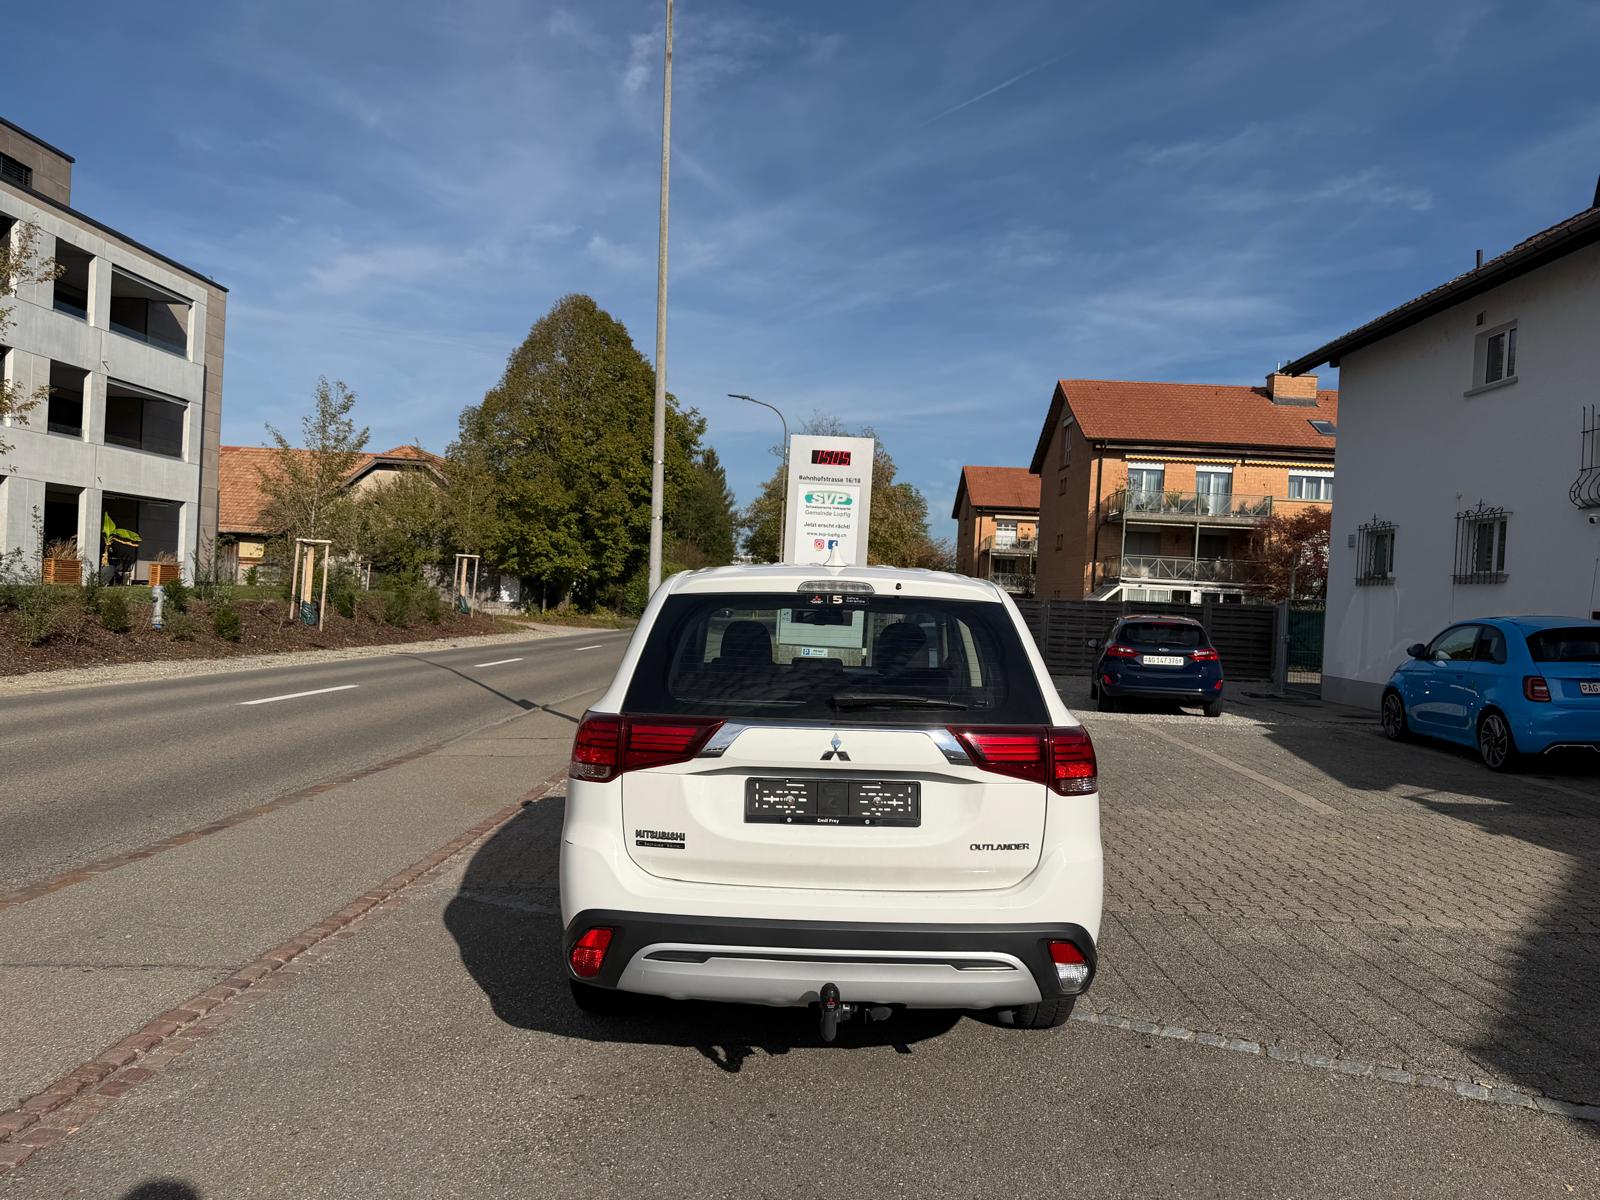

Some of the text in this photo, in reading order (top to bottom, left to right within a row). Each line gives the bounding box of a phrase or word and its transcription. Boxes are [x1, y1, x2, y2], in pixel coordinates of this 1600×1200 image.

[798, 474, 844, 483] Bahnhofstrasse
[810, 492, 850, 505] SVP
[804, 509, 833, 517] Gemeinde
[832, 595, 843, 604] 5
[1588, 684, 1599, 693] AG
[635, 829, 686, 842] MITSUBISHI
[969, 843, 1030, 851] OUTLANDER
